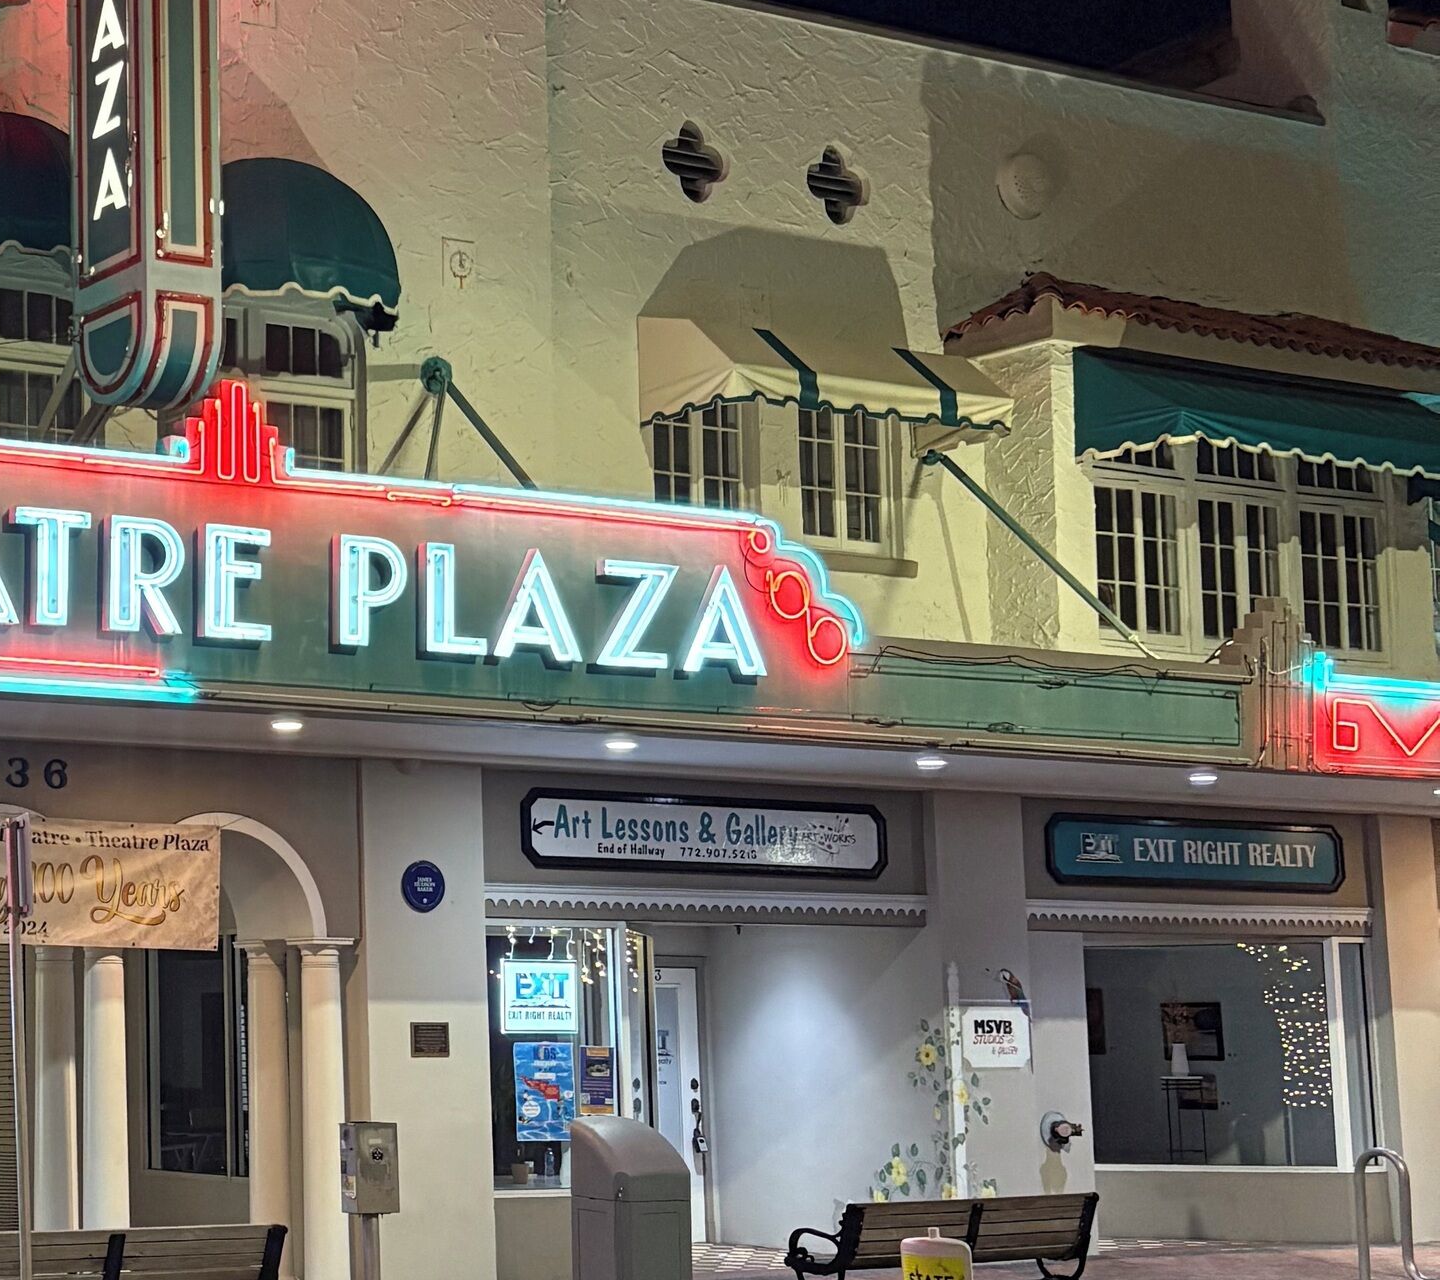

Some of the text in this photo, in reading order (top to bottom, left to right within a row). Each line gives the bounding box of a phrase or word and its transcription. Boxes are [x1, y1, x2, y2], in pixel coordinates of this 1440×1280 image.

[331, 533, 767, 677] PLAZA
[554, 803, 798, 850] Art Lessons & Gallery
[85, 829, 159, 850] Theatre
[162, 833, 211, 853] Plaza
[597, 843, 615, 854] End
[617, 844, 627, 854] of
[630, 844, 665, 859] Hallway
[1133, 837, 1317, 868] EXIT RIGHT REALTY
[79, 854, 186, 927] Years
[508, 1011, 572, 1021] EXIT RIGHT REALTY
[973, 1019, 1013, 1035] MSVB
